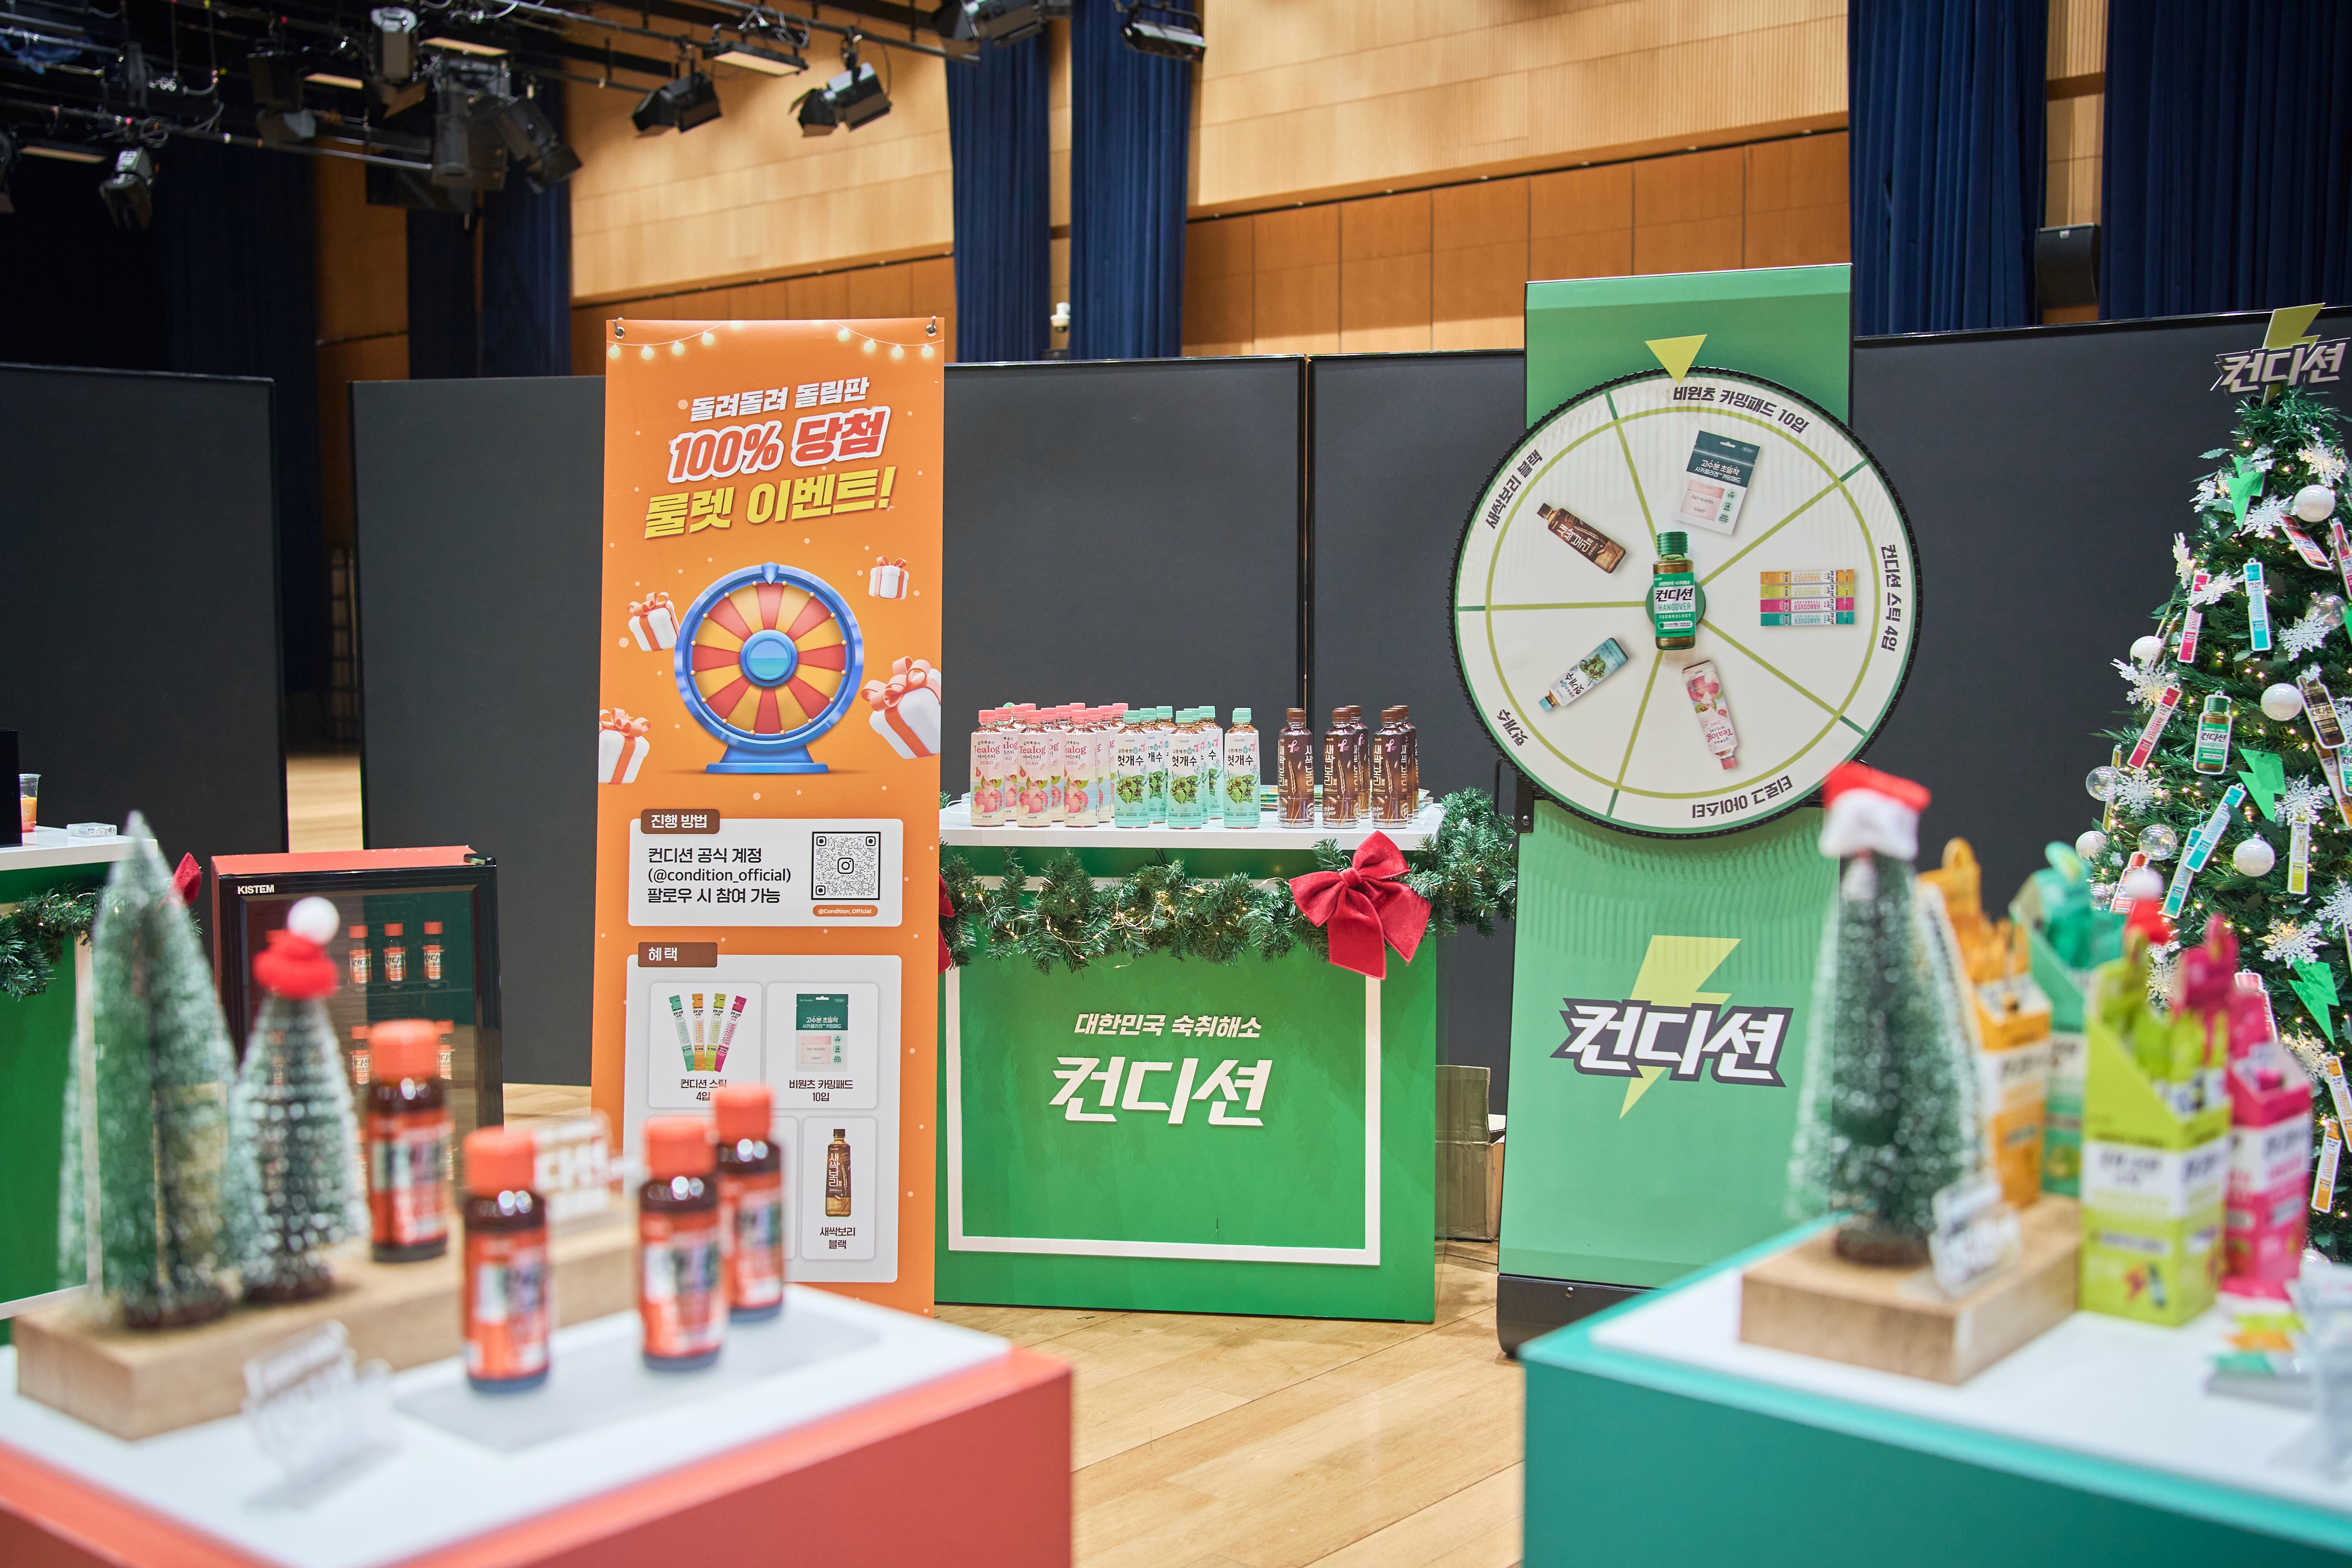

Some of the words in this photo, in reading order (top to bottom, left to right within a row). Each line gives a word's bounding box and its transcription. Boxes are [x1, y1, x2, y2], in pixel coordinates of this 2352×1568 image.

[2220, 343, 2346, 393] 컨디션
[691, 387, 789, 422] 돌려돌려
[795, 377, 869, 409] 돌림판
[1674, 386, 1716, 402] 비원츠
[1720, 389, 1778, 417] 카밍패드
[1776, 410, 1809, 434] 10입
[669, 421, 783, 483] 100%
[791, 406, 891, 466] 당첨
[1485, 474, 1522, 529] 새싹보리
[1517, 449, 1543, 478] 블랙
[644, 486, 734, 539] 룰렛
[747, 466, 896, 524] 이벤트!
[1881, 544, 1902, 588] 컨디션
[1656, 588, 1693, 602] 컨디션
[1658, 603, 1691, 611] HANGOVER
[1887, 593, 1902, 622] 스틱
[1881, 628, 1899, 652] 4입
[1565, 673, 1584, 696] 헛개수
[1497, 709, 1529, 747] 헛개수
[1706, 729, 1734, 743] Tealog
[2200, 732, 2227, 743] 컨디션
[974, 745, 1000, 754] Tealog
[1019, 745, 1046, 755] Tealog
[1148, 752, 1162, 763] 개수
[1117, 755, 1144, 766] 헛개수
[1172, 755, 1197, 767] 헛개수
[1228, 755, 1254, 766] 헛개수
[1324, 744, 1335, 786] 새싹보리
[1373, 745, 1383, 786] 새싹보리
[1751, 775, 1793, 806] 티로그
[1692, 795, 1748, 818] 아이스티
[651, 814, 678, 829] 진행
[681, 814, 707, 828] 방법
[648, 848, 693, 864] 컨디션
[697, 848, 727, 863] 공식
[732, 848, 762, 863] 계정
[648, 868, 791, 884] (@condition_official)
[237, 884, 275, 895] KISTEM
[648, 888, 692, 903] 팔로우
[697, 888, 712, 903] 시
[716, 888, 746, 903] 참여
[751, 888, 780, 903] 가능
[648, 947, 678, 962] 혜택
[1074, 1013, 1166, 1036] 대한민국
[1172, 1015, 1262, 1038] 숙취해소
[1564, 1005, 1785, 1081] 컨디션
[681, 1079, 706, 1089] 컨디션
[709, 1079, 727, 1089] 스틱
[789, 1080, 815, 1089] 비원츠
[818, 1080, 853, 1090] 카밍패드
[1049, 1056, 1272, 1126] 컨디션
[696, 1092, 710, 1101] 4입
[812, 1092, 829, 1102] 10입
[829, 1153, 840, 1187] 새싹보리
[820, 1227, 855, 1237] 새싹보리
[828, 1240, 847, 1249] 블랙
